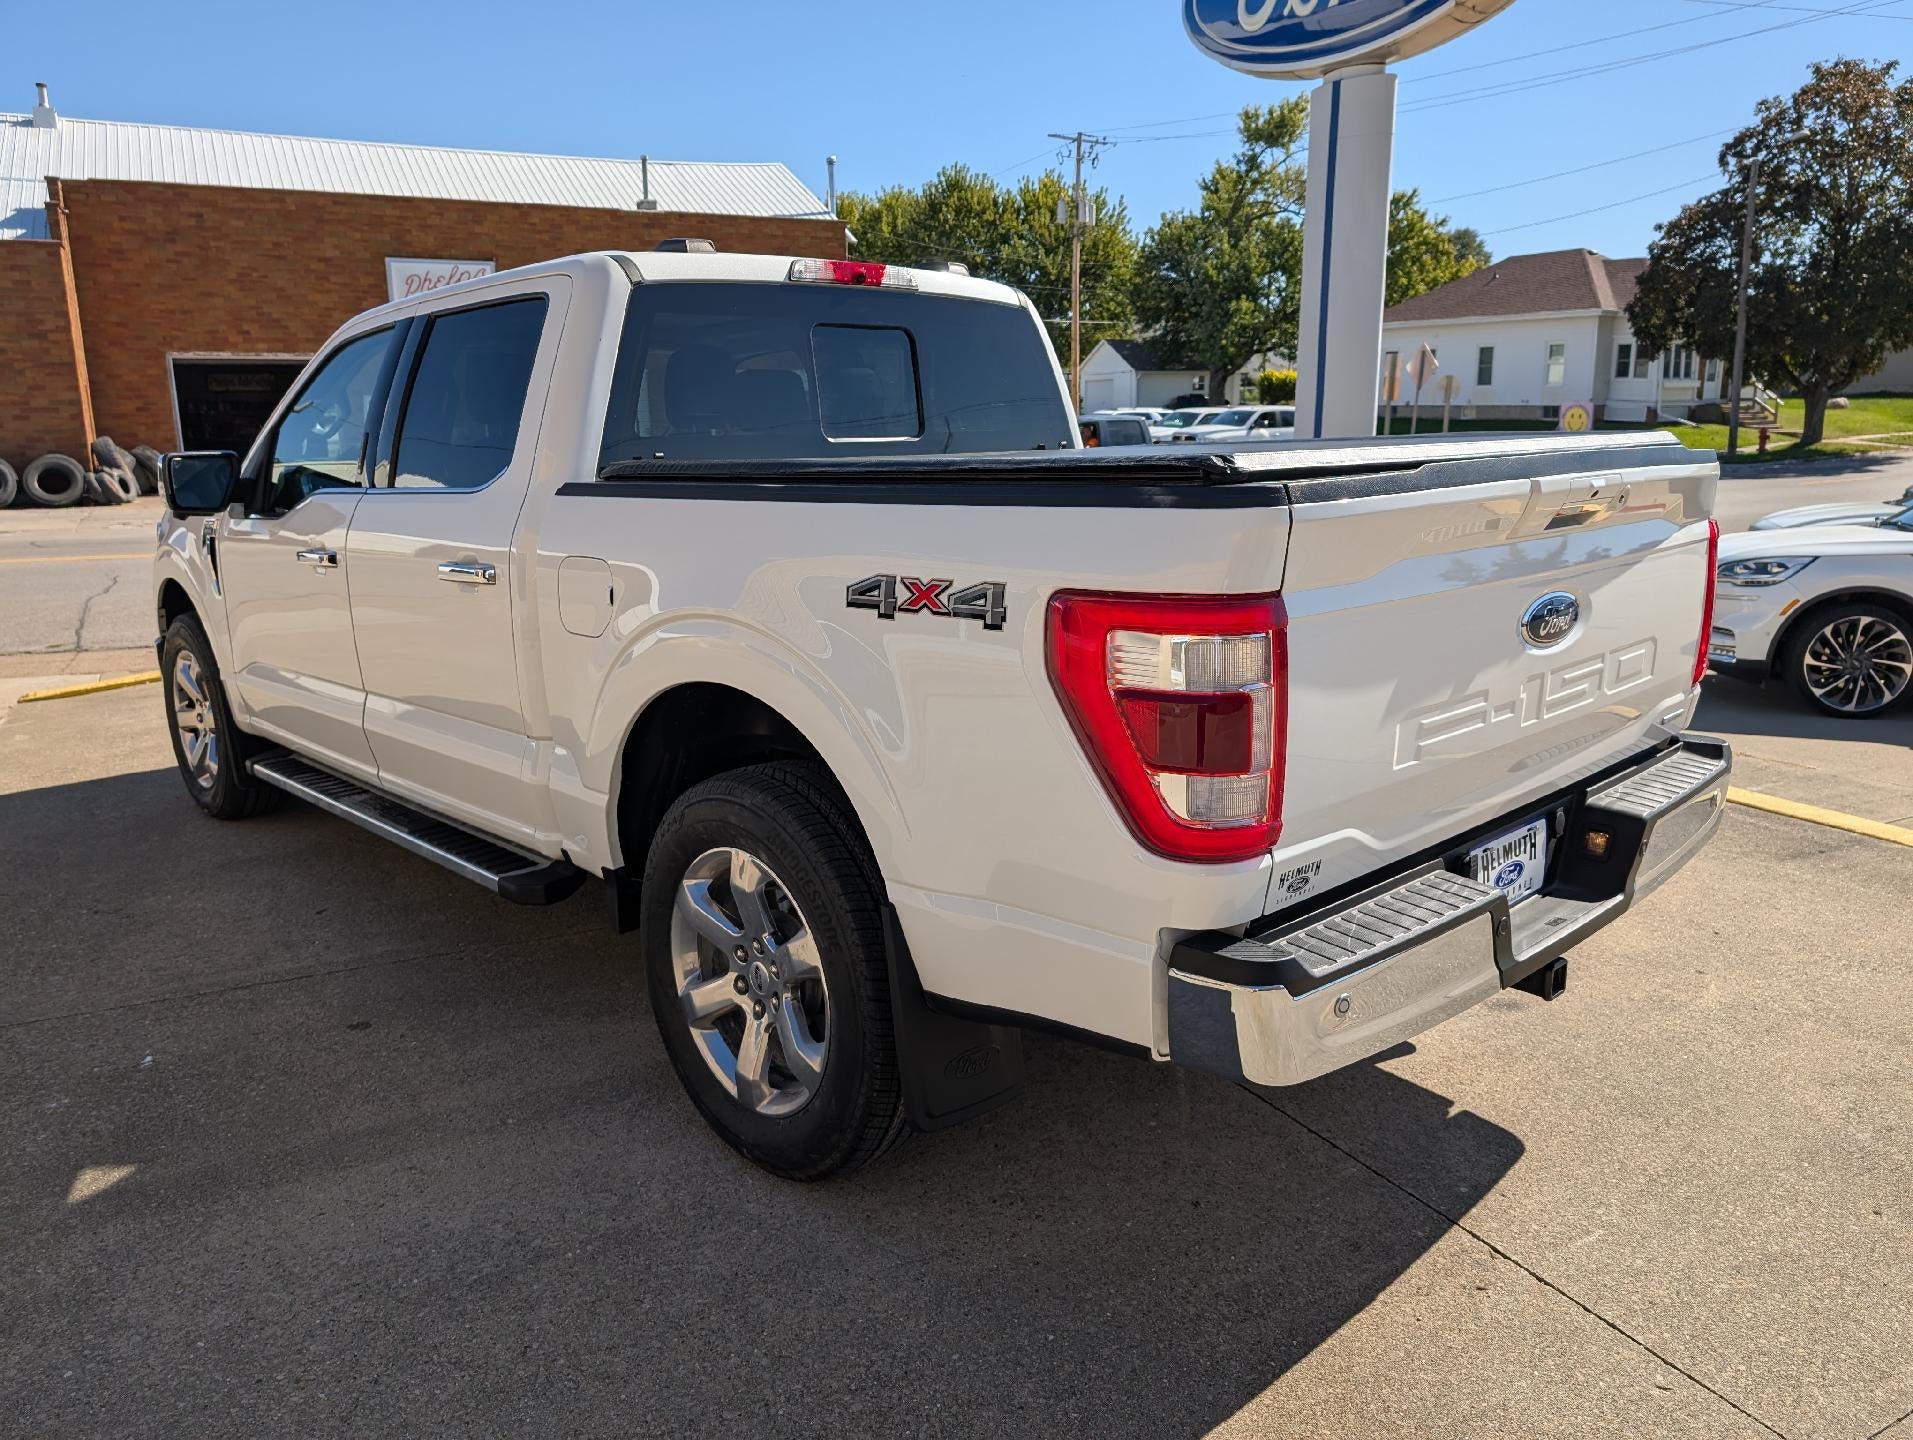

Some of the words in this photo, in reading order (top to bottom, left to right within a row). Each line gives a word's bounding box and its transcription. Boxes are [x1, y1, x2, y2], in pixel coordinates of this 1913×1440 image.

[1539, 603, 1572, 637] Ford
[1393, 636, 1658, 770] F-150
[1278, 859, 1322, 890] HELMUTH
[1481, 831, 1537, 883] HELMUTH
